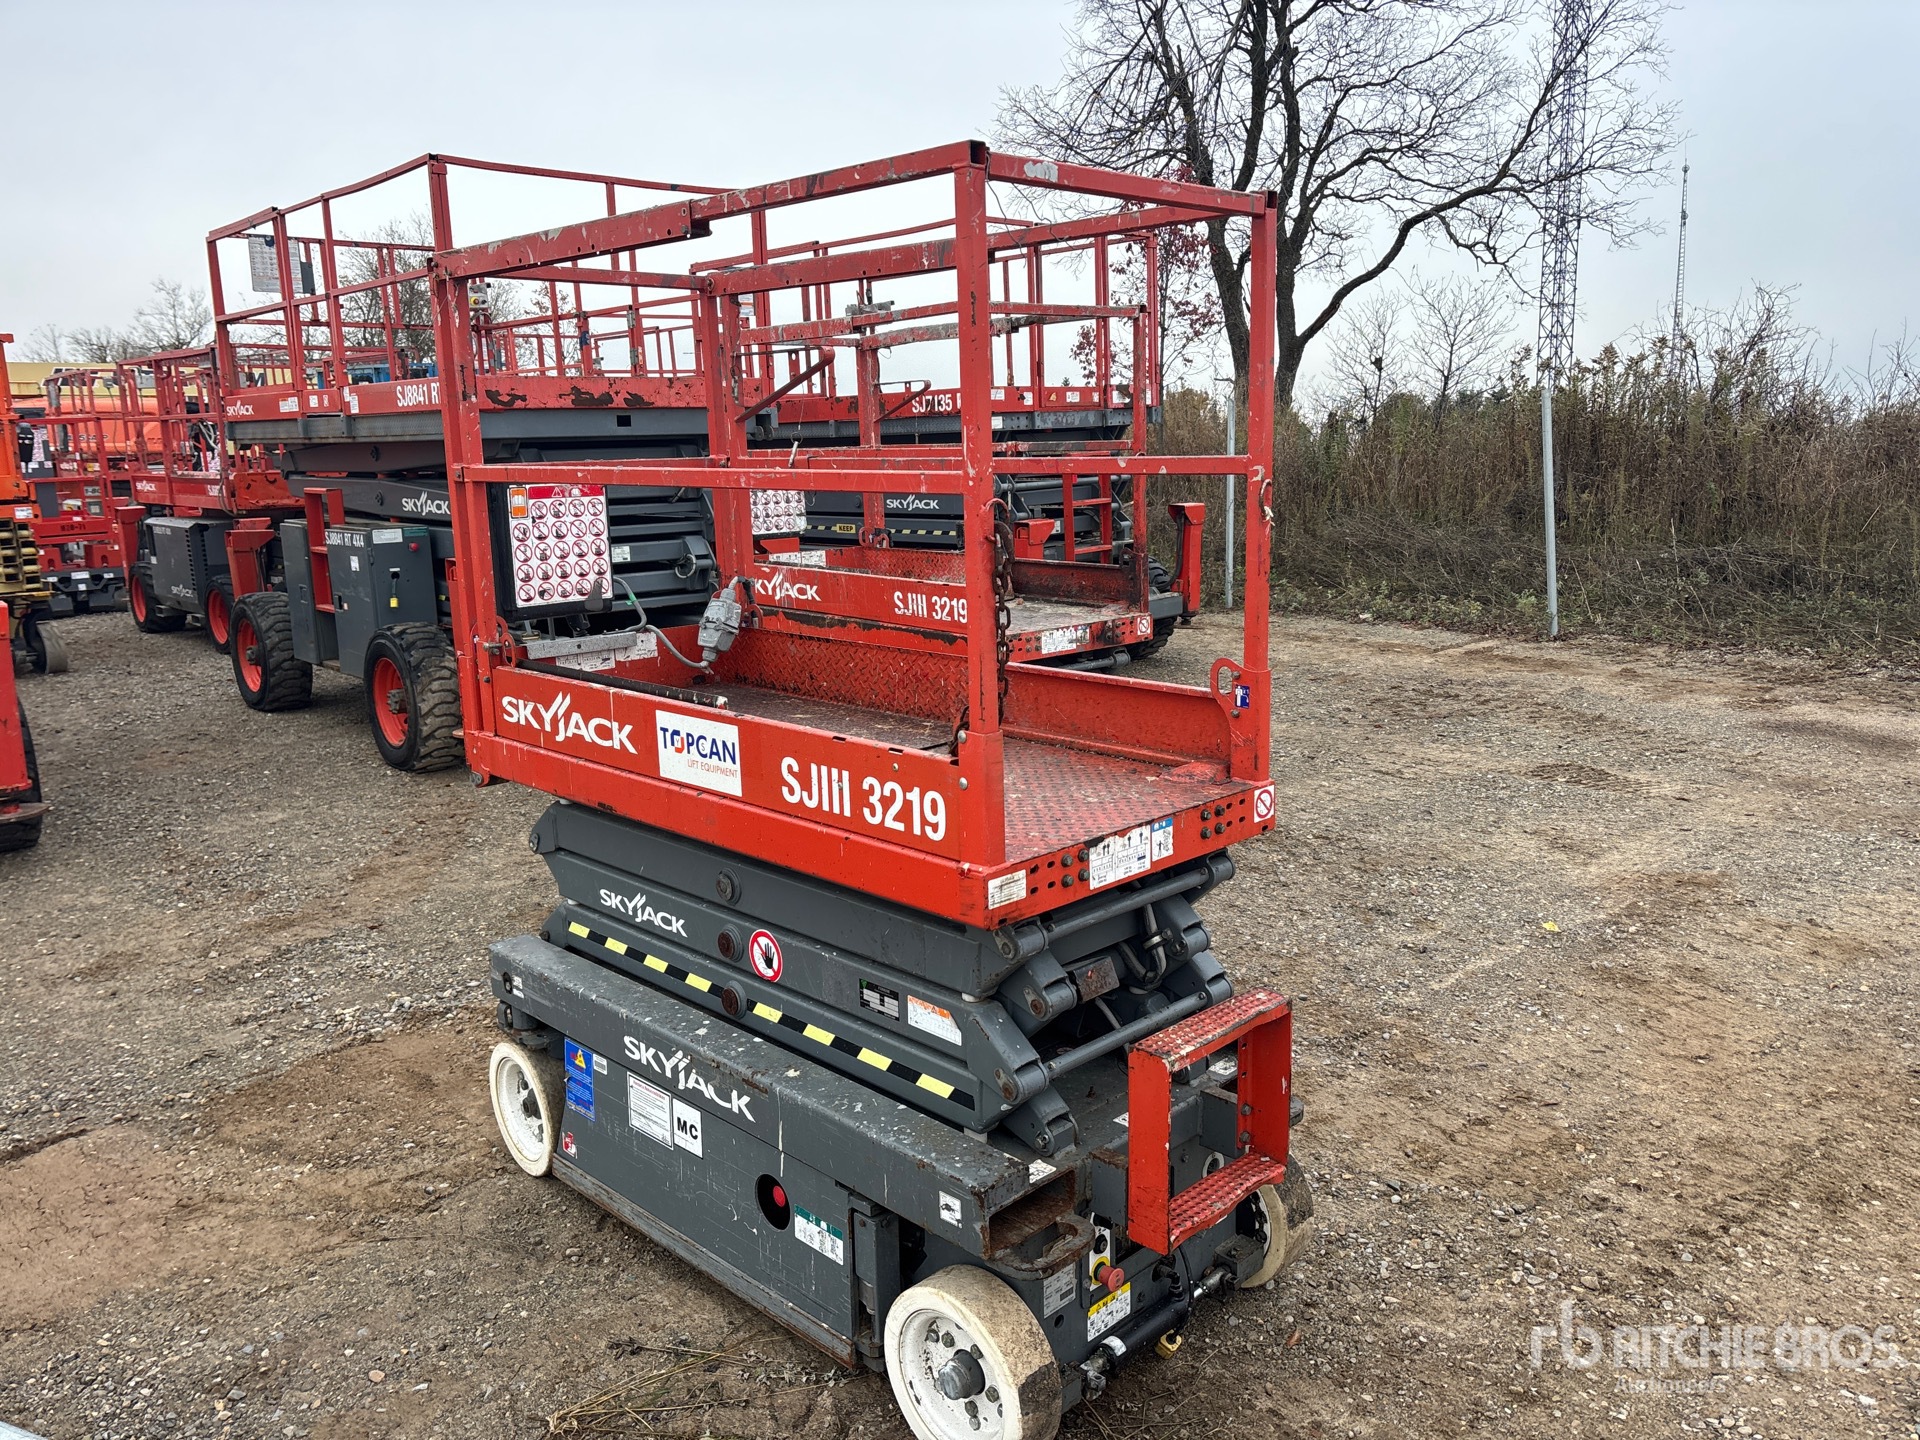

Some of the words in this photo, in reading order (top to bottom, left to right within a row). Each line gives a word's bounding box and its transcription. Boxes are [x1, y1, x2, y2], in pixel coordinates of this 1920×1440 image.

[396, 383, 429, 407] SJ8841
[911, 393, 953, 413] SJ7135
[226, 400, 254, 417] SKYJACK
[401, 490, 451, 516] SKYJACK
[886, 494, 940, 511] SKYJACK
[324, 531, 344, 546] SJ8841
[344, 533, 352, 547] RT
[352, 534, 365, 548] 4X4
[838, 524, 854, 533] KEEP
[754, 570, 822, 602] KYJACK
[894, 591, 927, 618] SJIII
[931, 595, 968, 624] 3219
[501, 691, 639, 755] SKYJACK
[659, 726, 737, 765] TOPCAN
[687, 759, 699, 770] LIFT
[700, 761, 738, 779] EQUIPMENT
[780, 756, 851, 818] SJIII
[862, 776, 947, 842] 3219
[599, 888, 688, 938] SKYJACK
[623, 1035, 757, 1123] SKYJACK
[676, 1116, 699, 1140] MC
